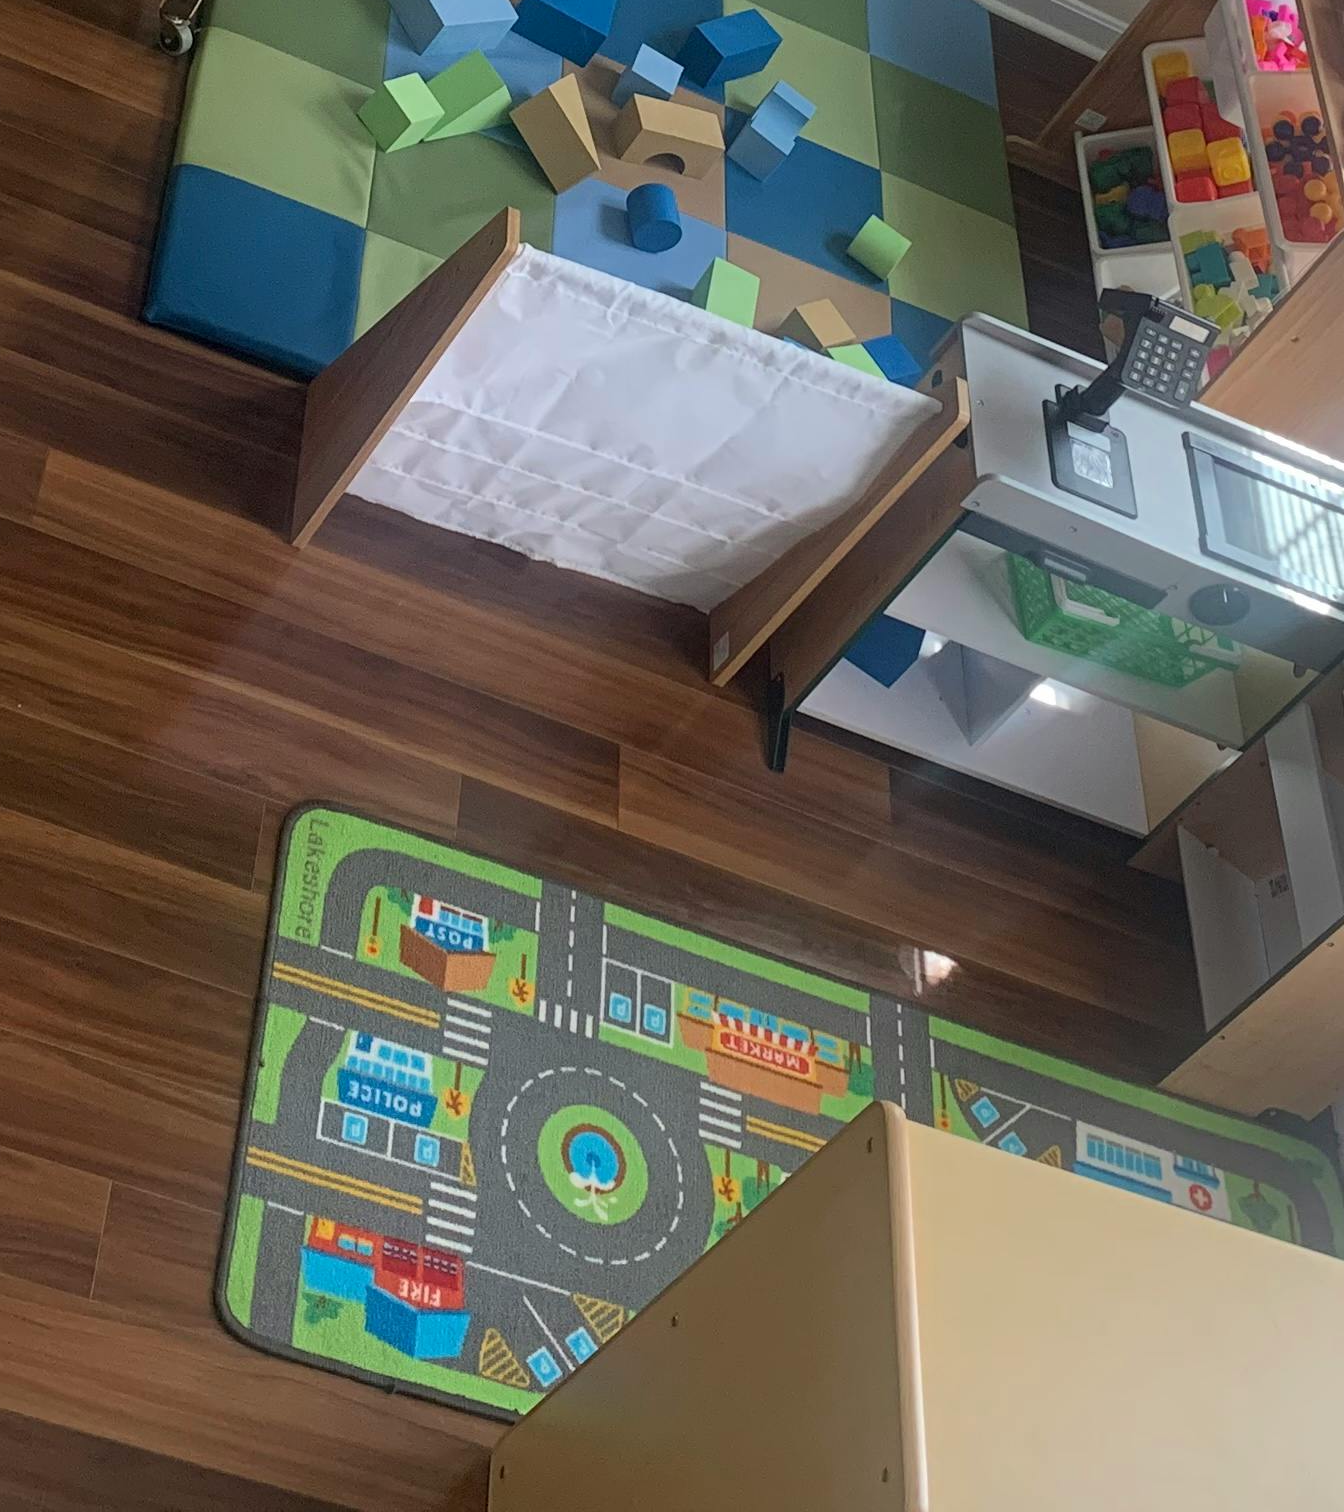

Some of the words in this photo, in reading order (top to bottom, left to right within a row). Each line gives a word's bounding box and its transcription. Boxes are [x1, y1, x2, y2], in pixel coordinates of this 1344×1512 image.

[294, 817, 329, 939] Lakeshore
[425, 922, 473, 948] POST
[727, 1034, 801, 1071] MARKET
[347, 1080, 423, 1118] POLICE
[398, 1277, 442, 1307] FIRE
